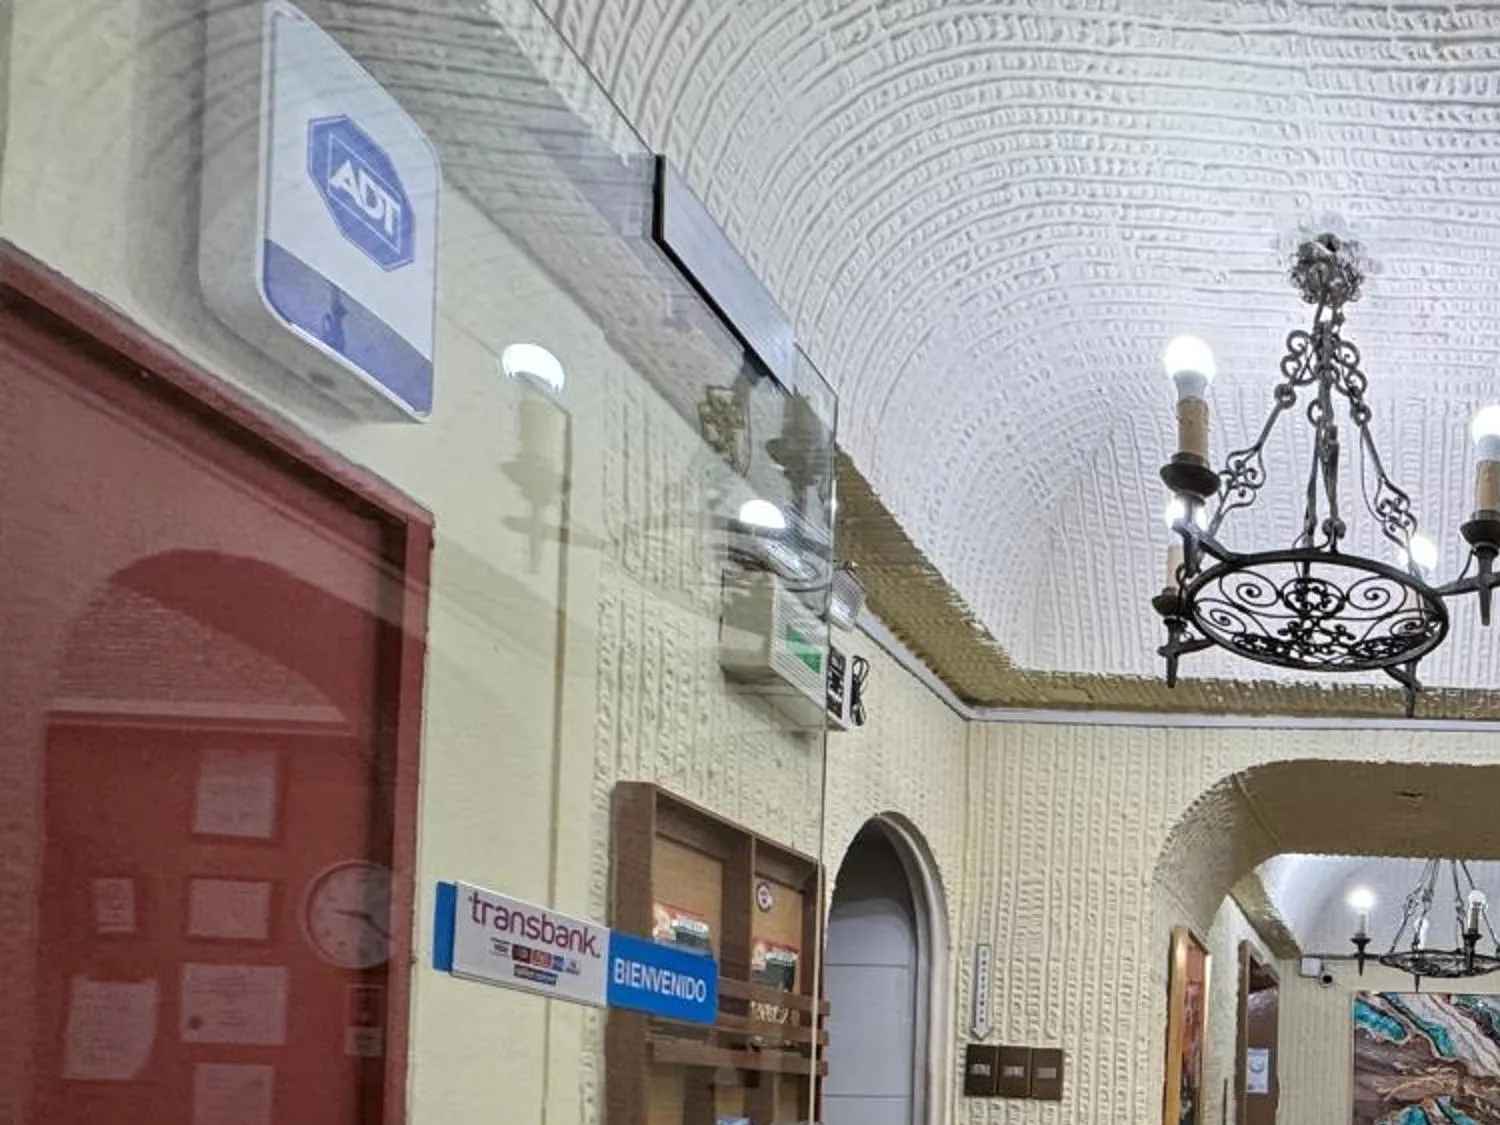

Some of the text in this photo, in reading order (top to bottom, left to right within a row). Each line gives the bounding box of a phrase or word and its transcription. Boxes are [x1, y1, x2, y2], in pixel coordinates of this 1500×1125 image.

[327, 159, 401, 236] ADT
[468, 891, 600, 958] transbank
[613, 957, 707, 1003] BIENVENIDO
